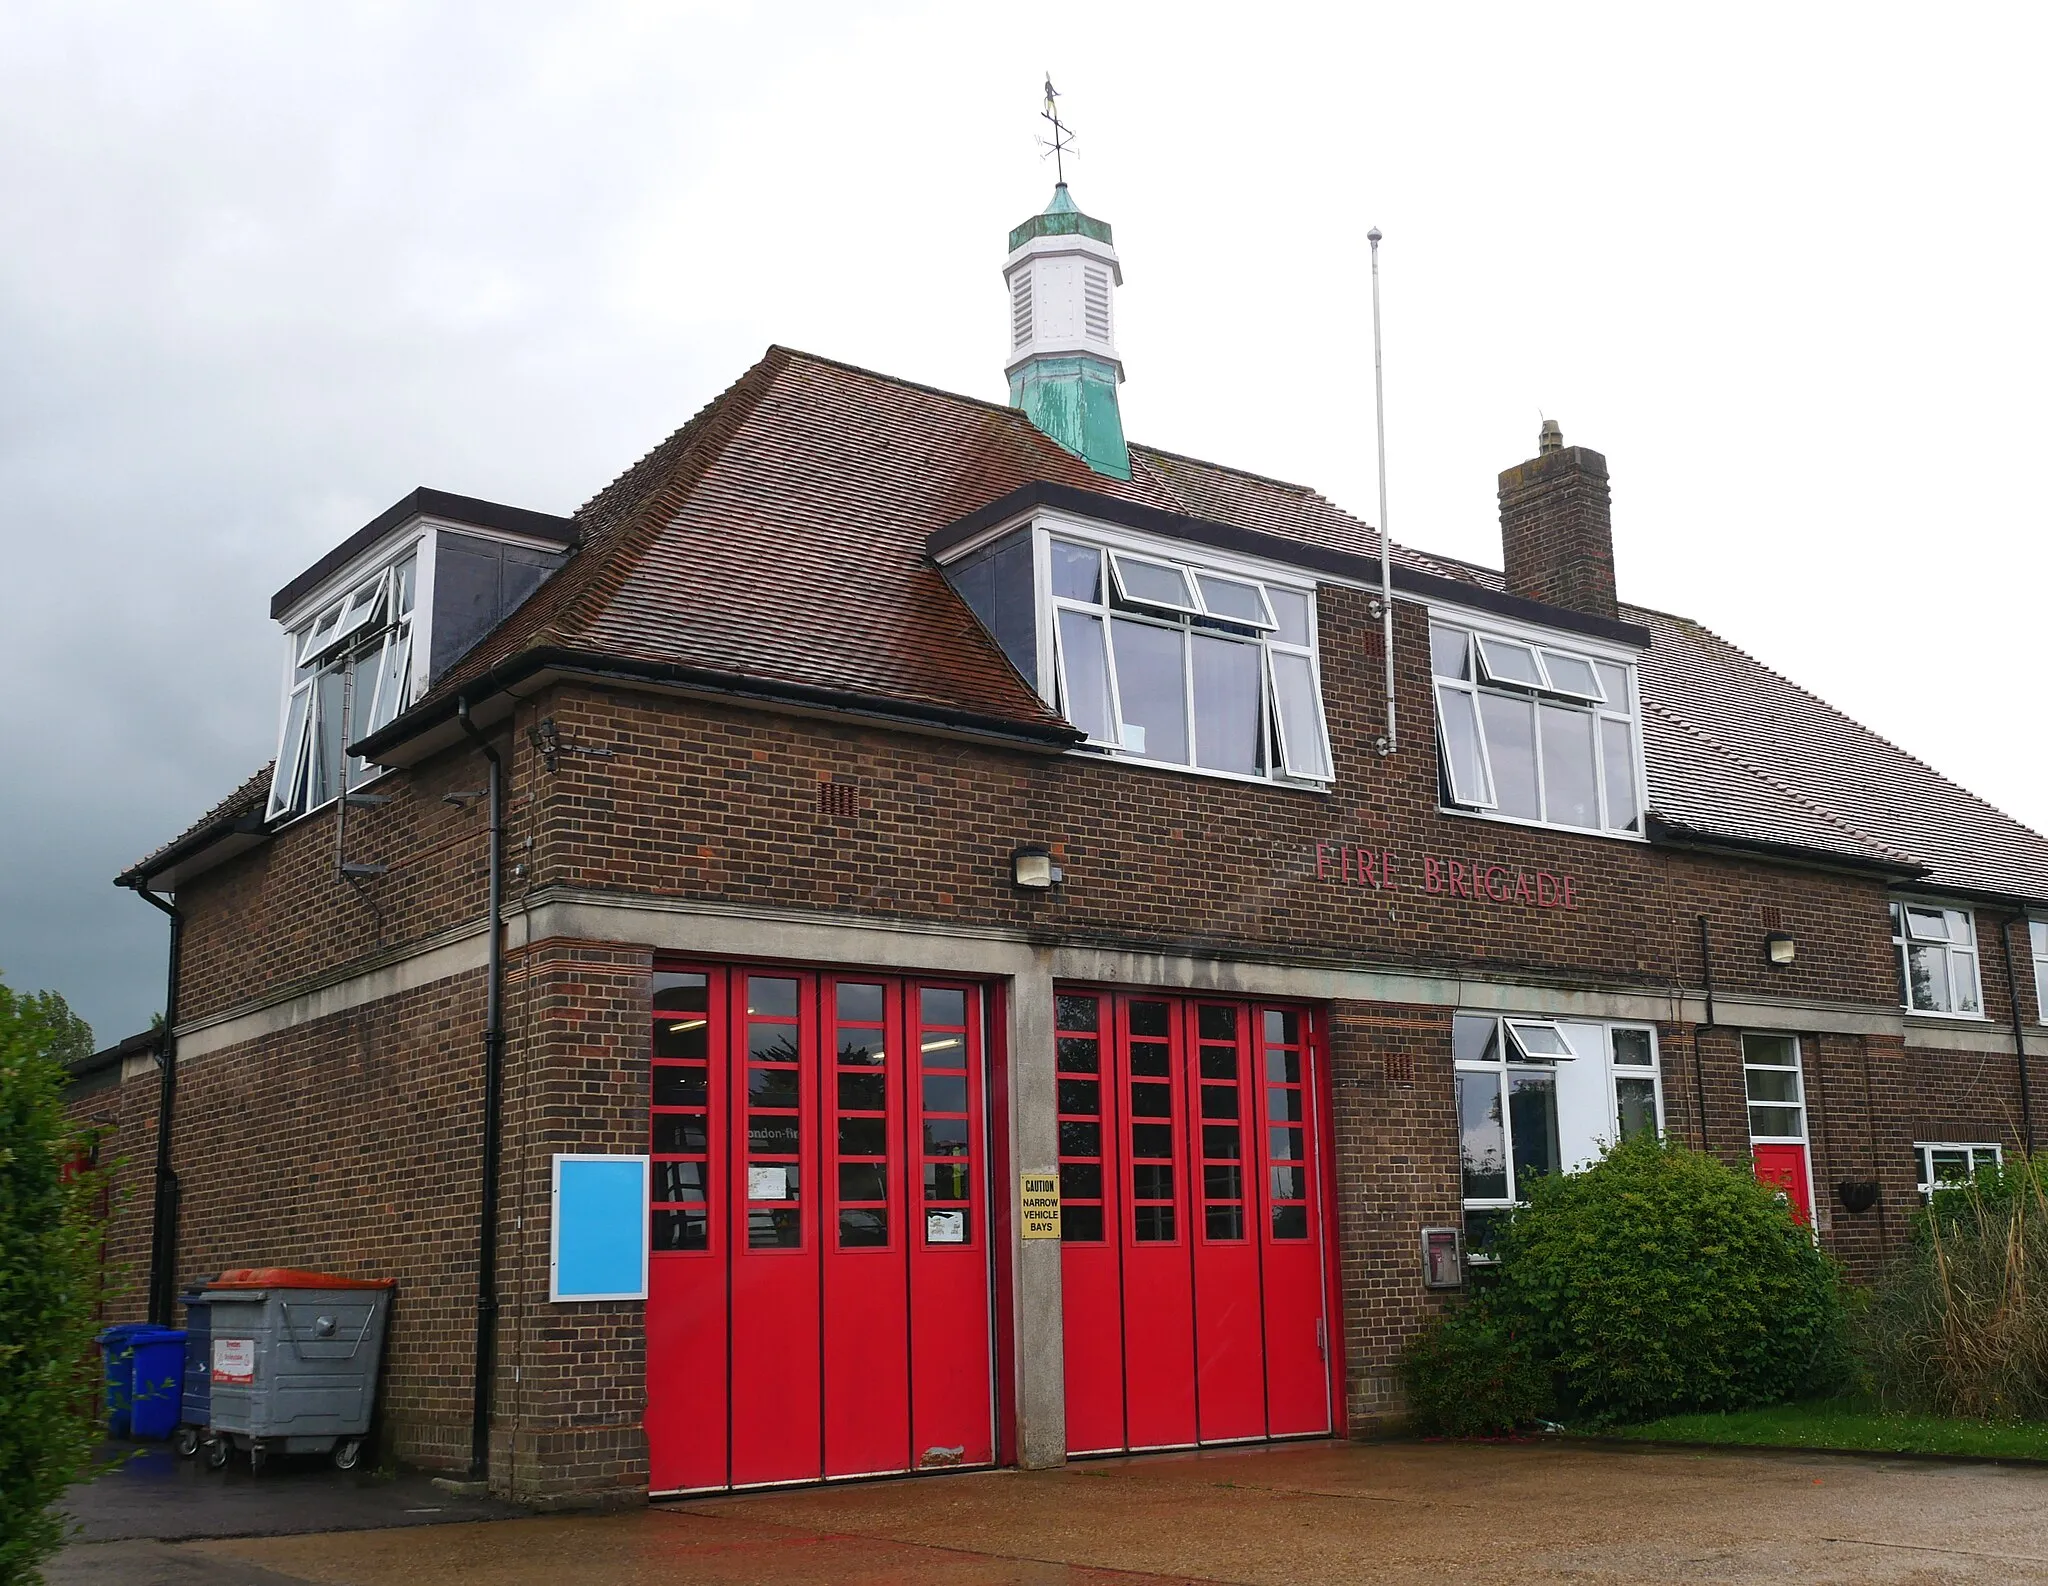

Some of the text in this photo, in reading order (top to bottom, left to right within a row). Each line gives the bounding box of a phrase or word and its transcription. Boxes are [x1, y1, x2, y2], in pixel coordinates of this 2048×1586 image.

[1315, 843, 1579, 911] FIRE BRIGADE
[1025, 1180, 1054, 1192] CAUTION
[1023, 1198, 1058, 1207] NARROW
[1023, 1210, 1059, 1219] VEHICLE
[1030, 1222, 1053, 1232] BAYS
